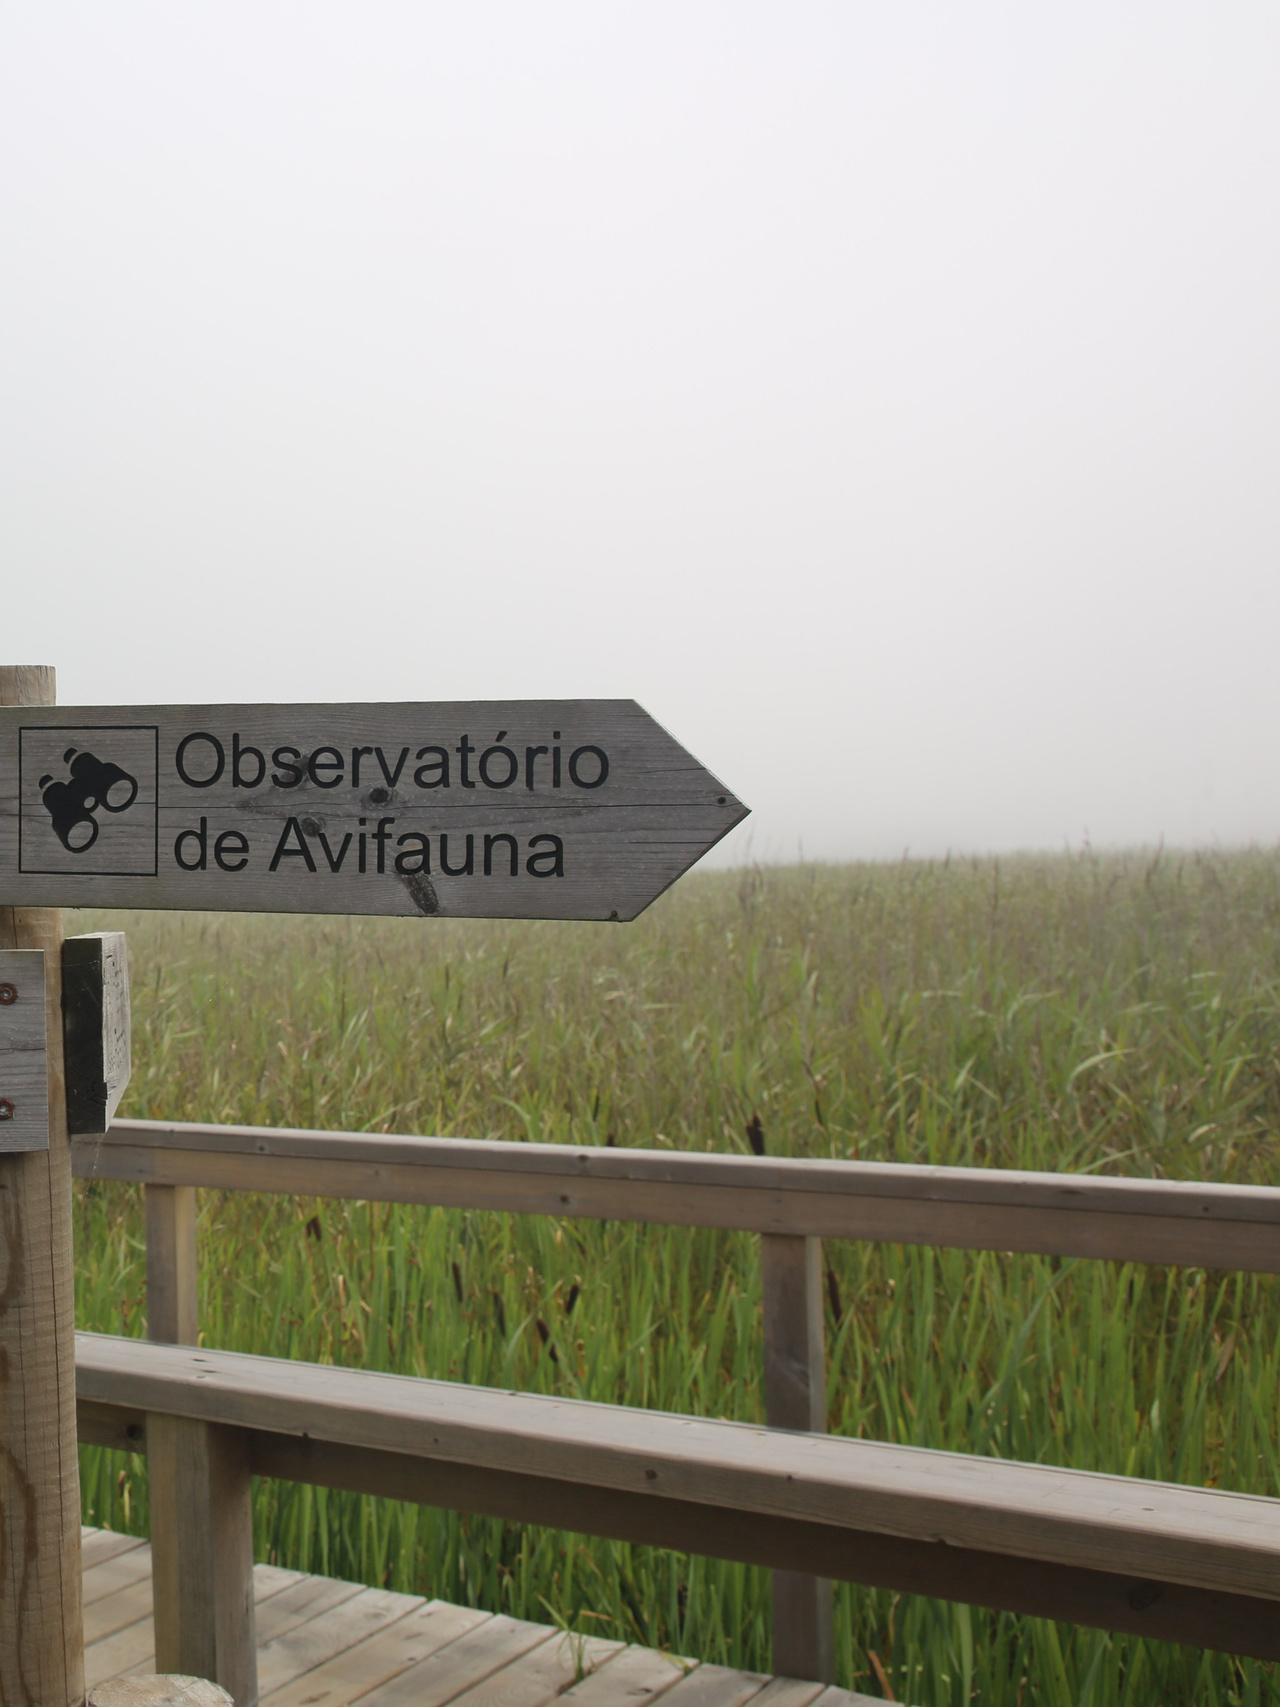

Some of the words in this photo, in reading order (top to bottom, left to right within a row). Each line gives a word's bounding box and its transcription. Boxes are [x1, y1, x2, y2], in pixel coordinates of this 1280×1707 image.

[175, 730, 609, 790] Observatório
[174, 816, 250, 872] de
[269, 817, 566, 877] Avifauna
